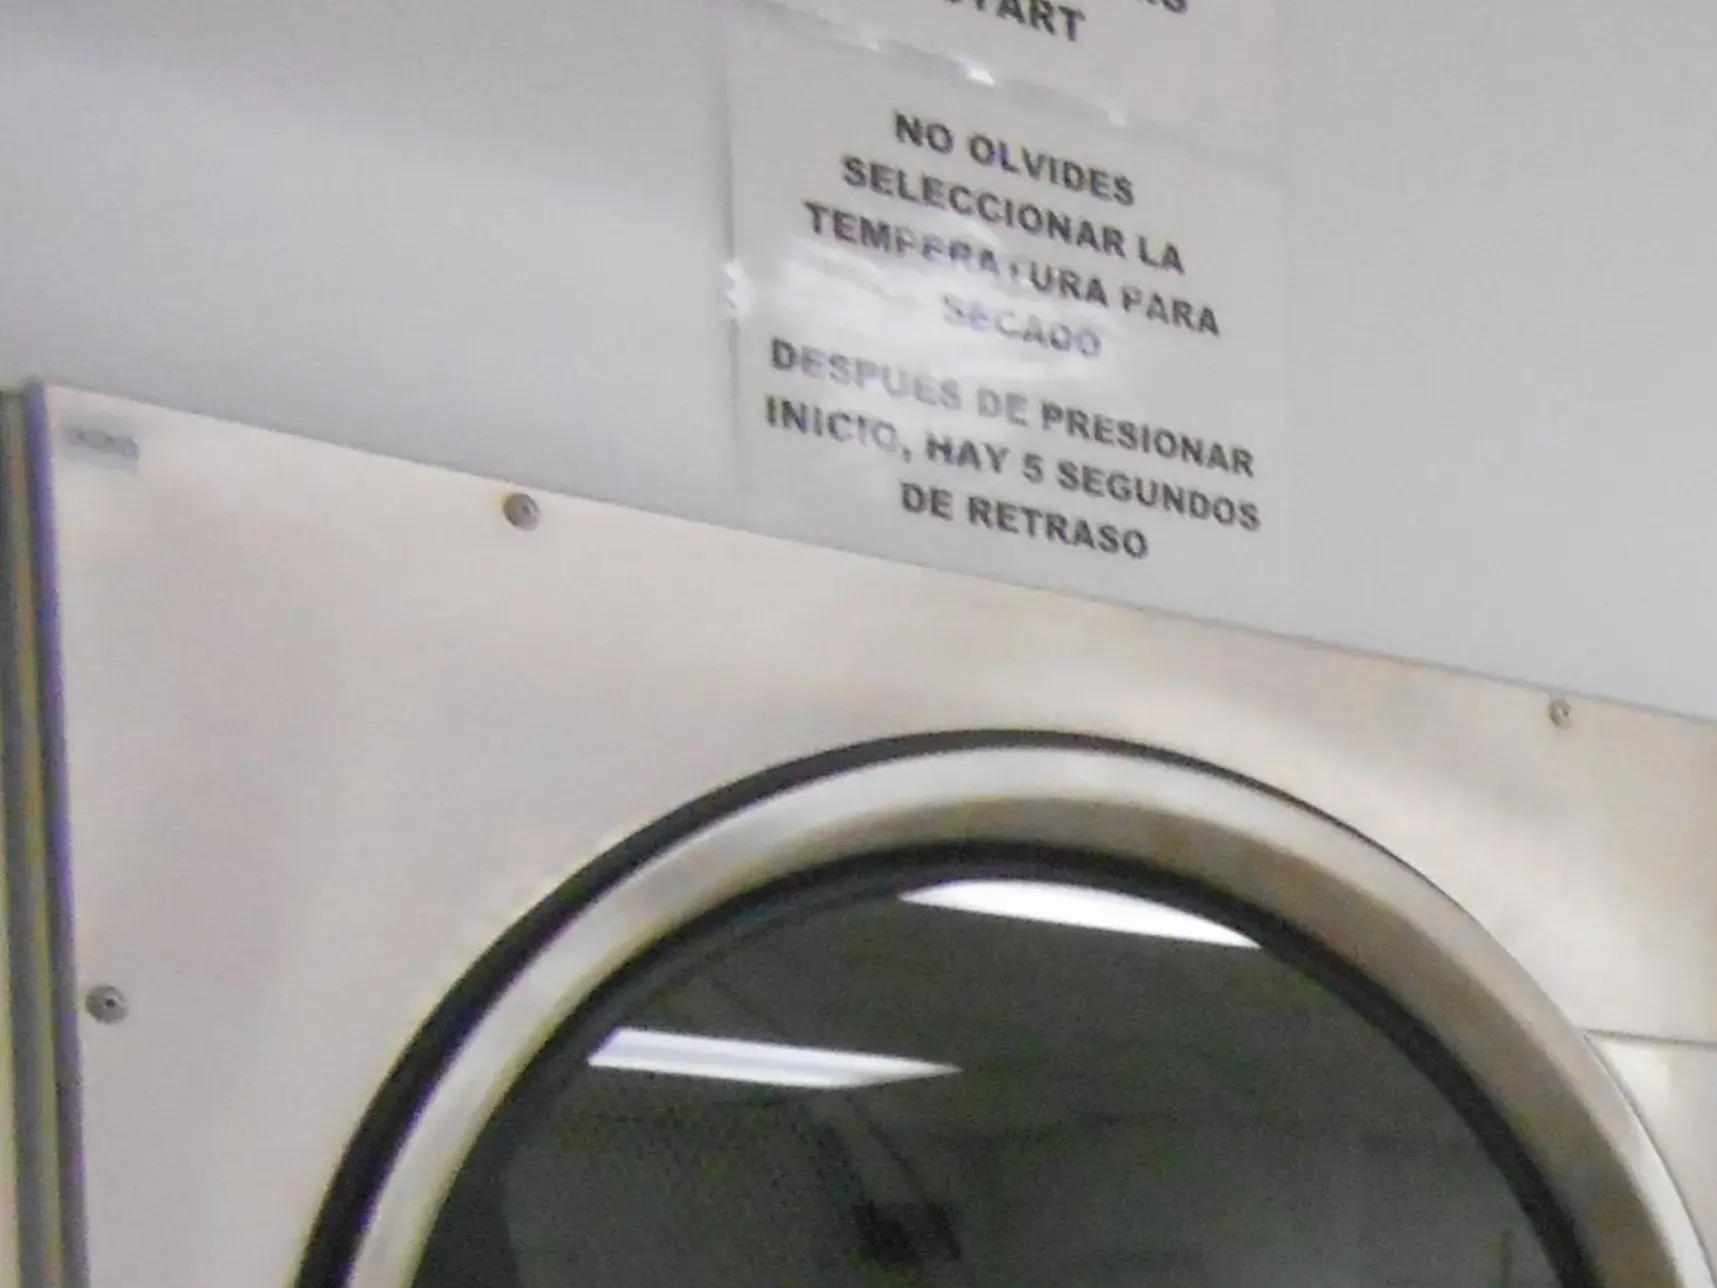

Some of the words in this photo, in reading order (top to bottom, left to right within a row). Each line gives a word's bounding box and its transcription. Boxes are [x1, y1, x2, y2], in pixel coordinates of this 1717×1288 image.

[895, 111, 954, 153] NO
[968, 133, 1135, 206] OLVIDES
[842, 153, 1127, 260] SELECCIONAR
[1137, 235, 1185, 275] LA
[1121, 285, 1220, 338] PARA
[770, 337, 962, 411] DESPUES
[977, 387, 1029, 427] DE
[1041, 400, 1254, 478] PRESIONAR
[764, 393, 912, 463] INICIO,
[926, 430, 1009, 473] HAY
[1022, 453, 1044, 484] 5
[1057, 460, 1261, 532] SEGUNDOS
[900, 480, 954, 521] DE
[968, 496, 1148, 559] RETRASO
